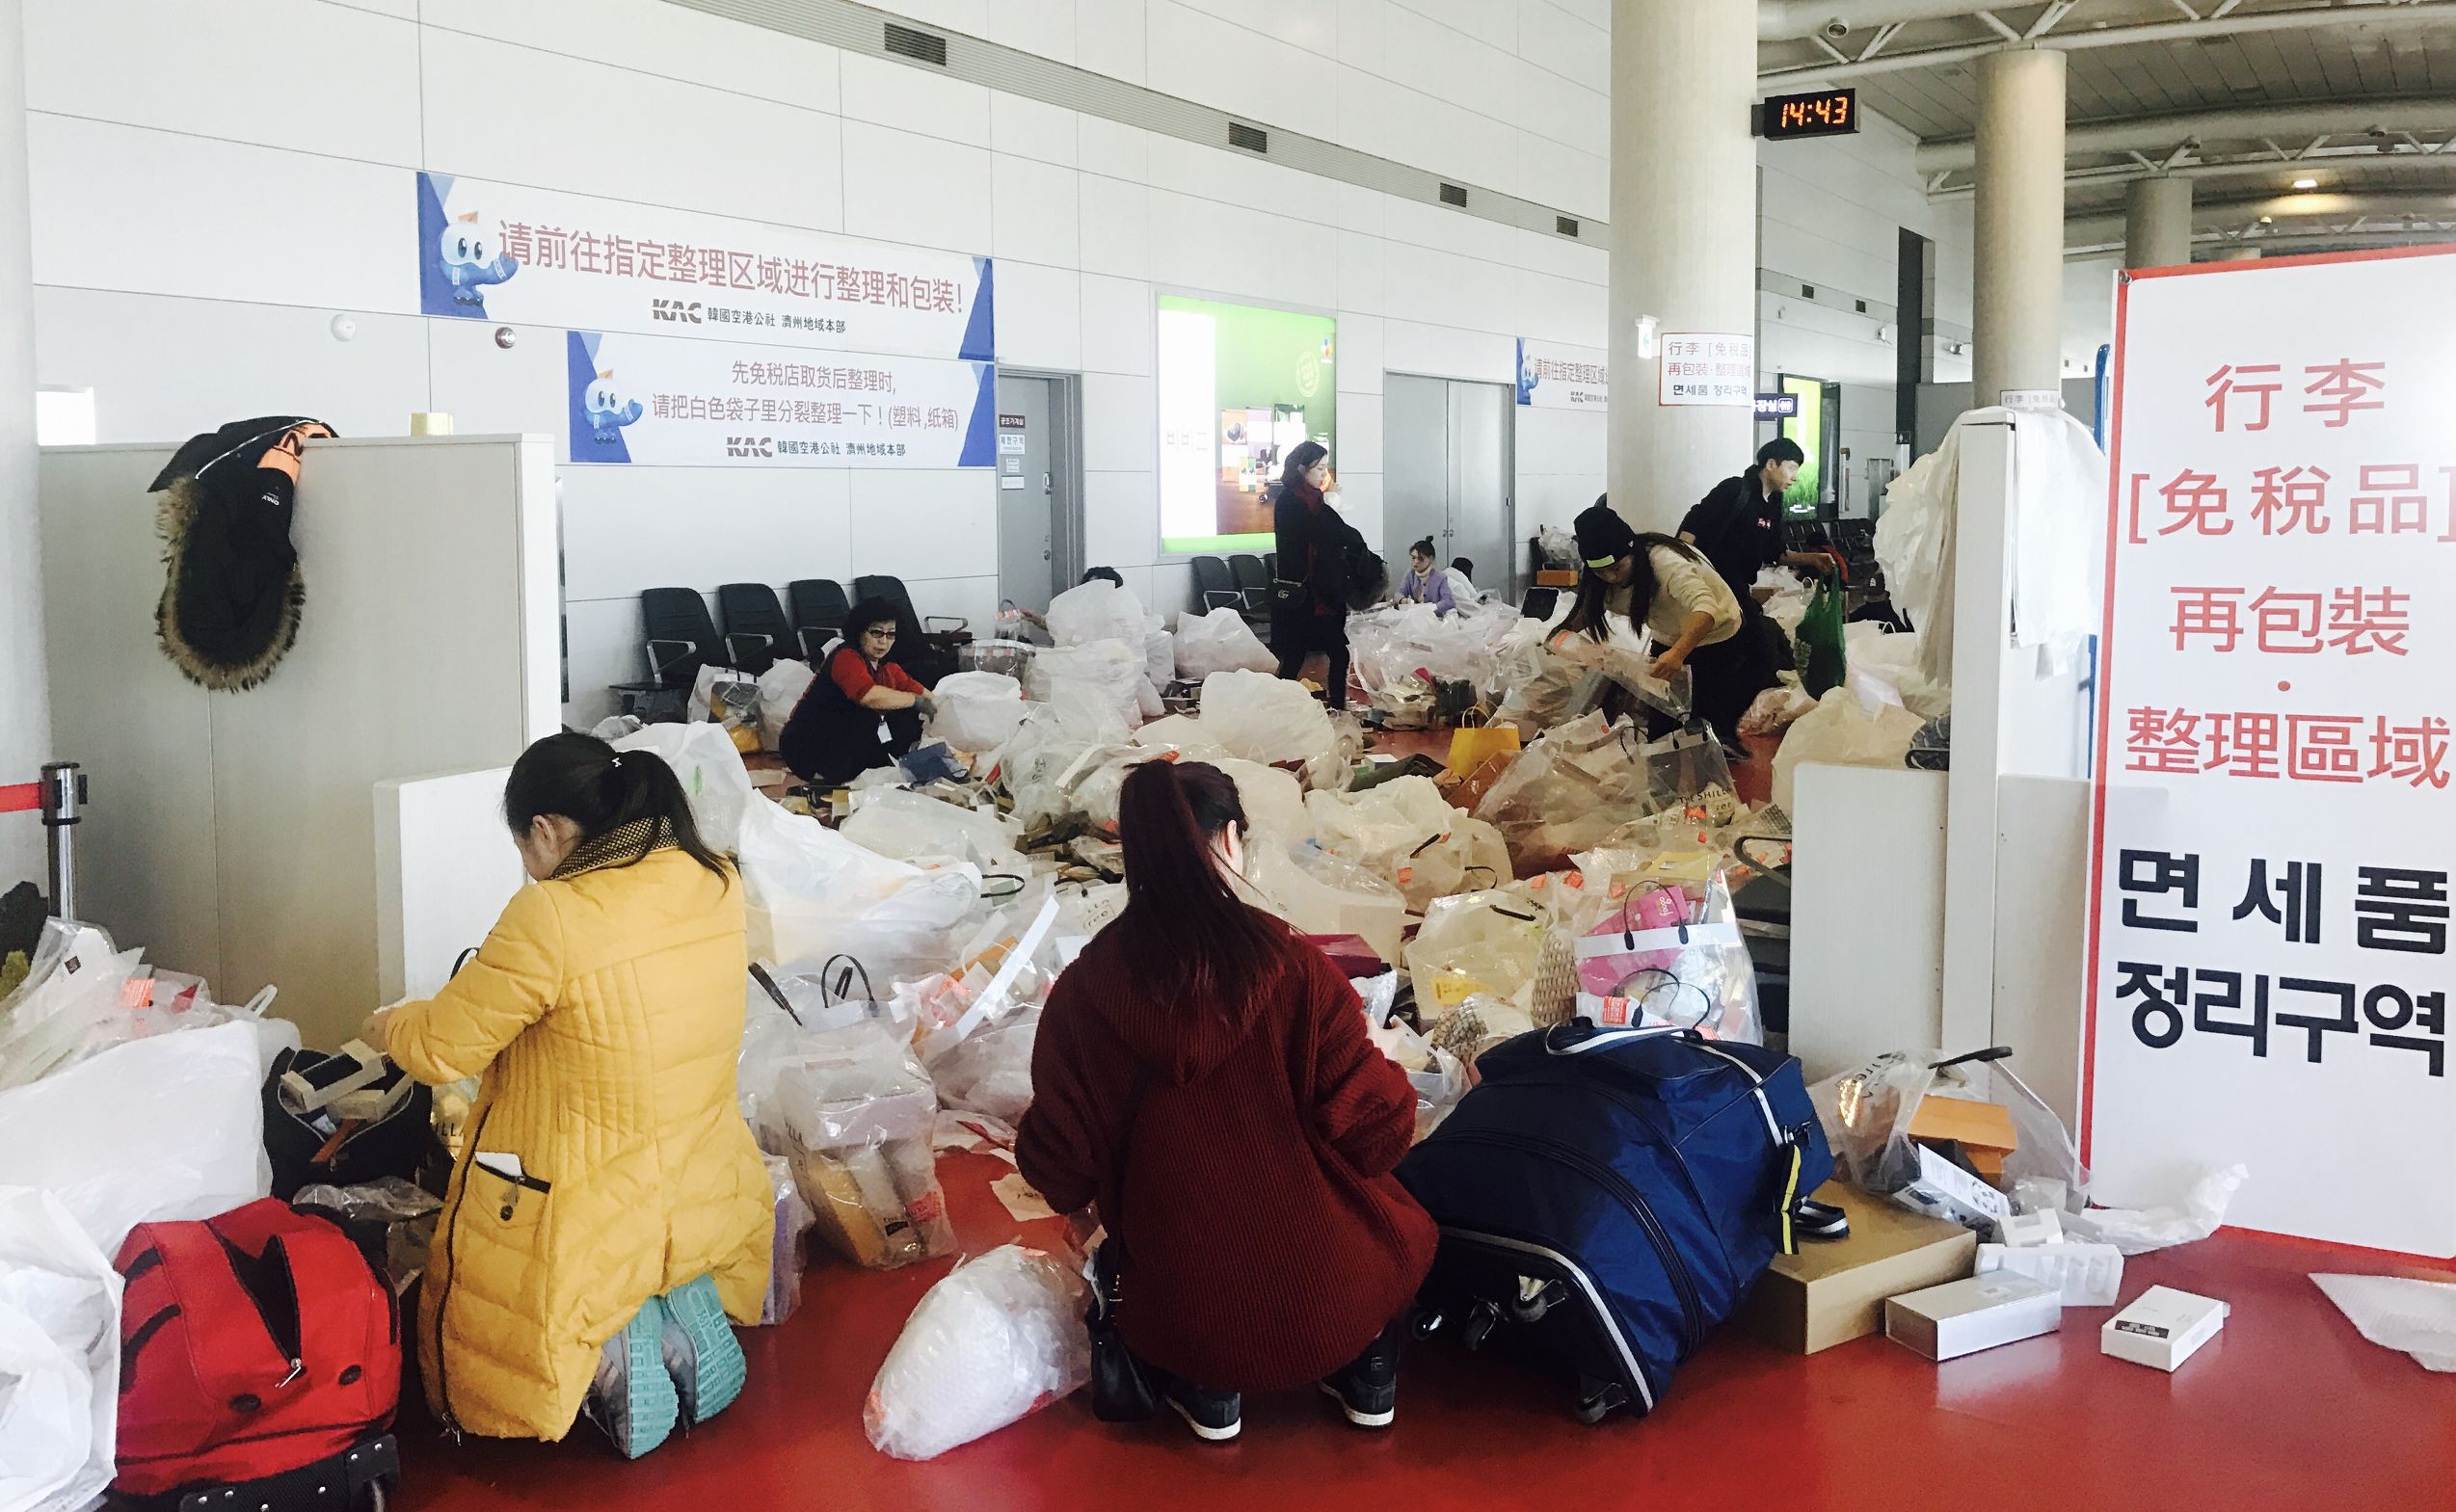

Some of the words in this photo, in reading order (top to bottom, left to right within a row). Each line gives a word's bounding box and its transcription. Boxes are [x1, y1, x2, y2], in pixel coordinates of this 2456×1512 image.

[1781, 96, 1848, 127] 14:43
[653, 299, 702, 324] KAC
[1673, 385, 1708, 396] 면세품
[2205, 358, 2385, 432] 行李
[726, 437, 772, 457] KAC
[2125, 706, 2450, 788] 整理區域
[2116, 961, 2445, 1077] 정리구역
